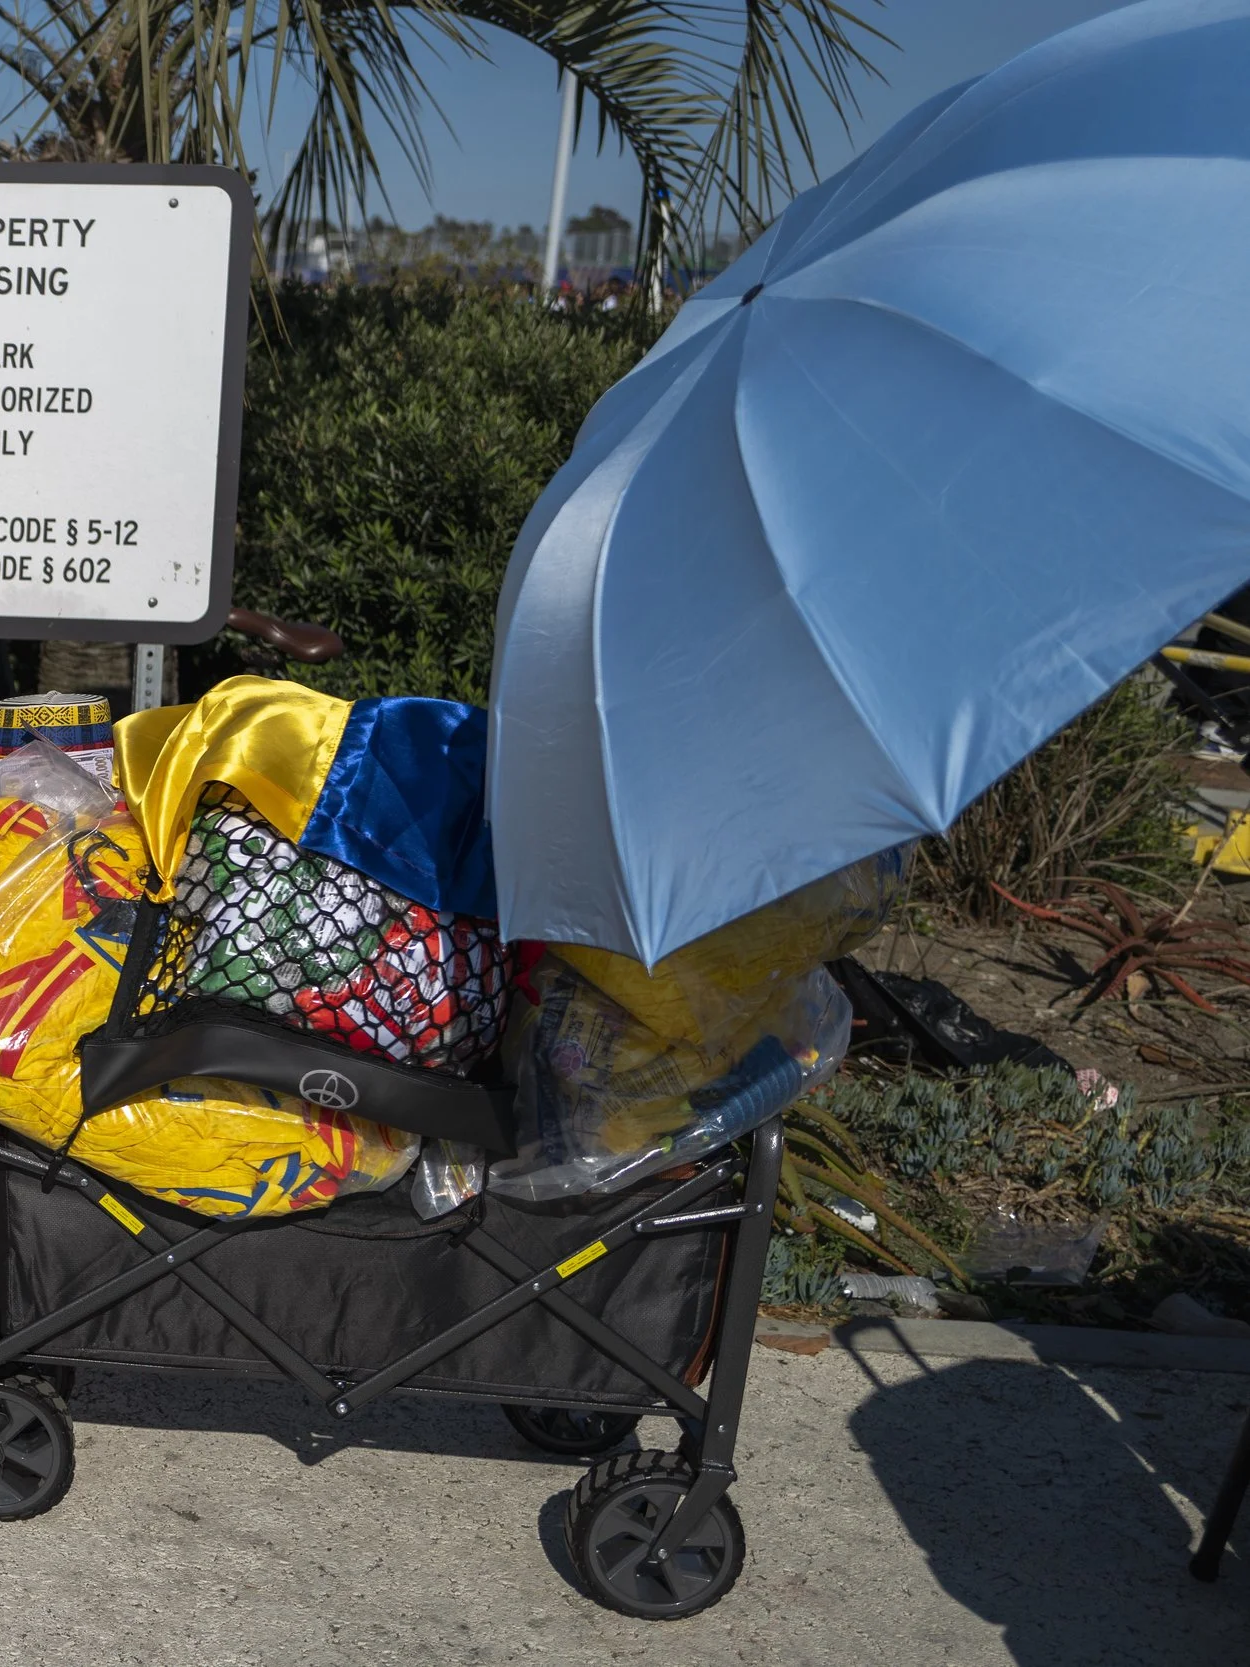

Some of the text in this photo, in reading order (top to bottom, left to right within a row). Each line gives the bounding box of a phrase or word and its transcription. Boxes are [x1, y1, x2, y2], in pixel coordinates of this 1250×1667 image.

[66, 518, 78, 547] §
[87, 519, 139, 546] 5-12
[42, 556, 54, 585] §
[63, 557, 111, 584] 602
